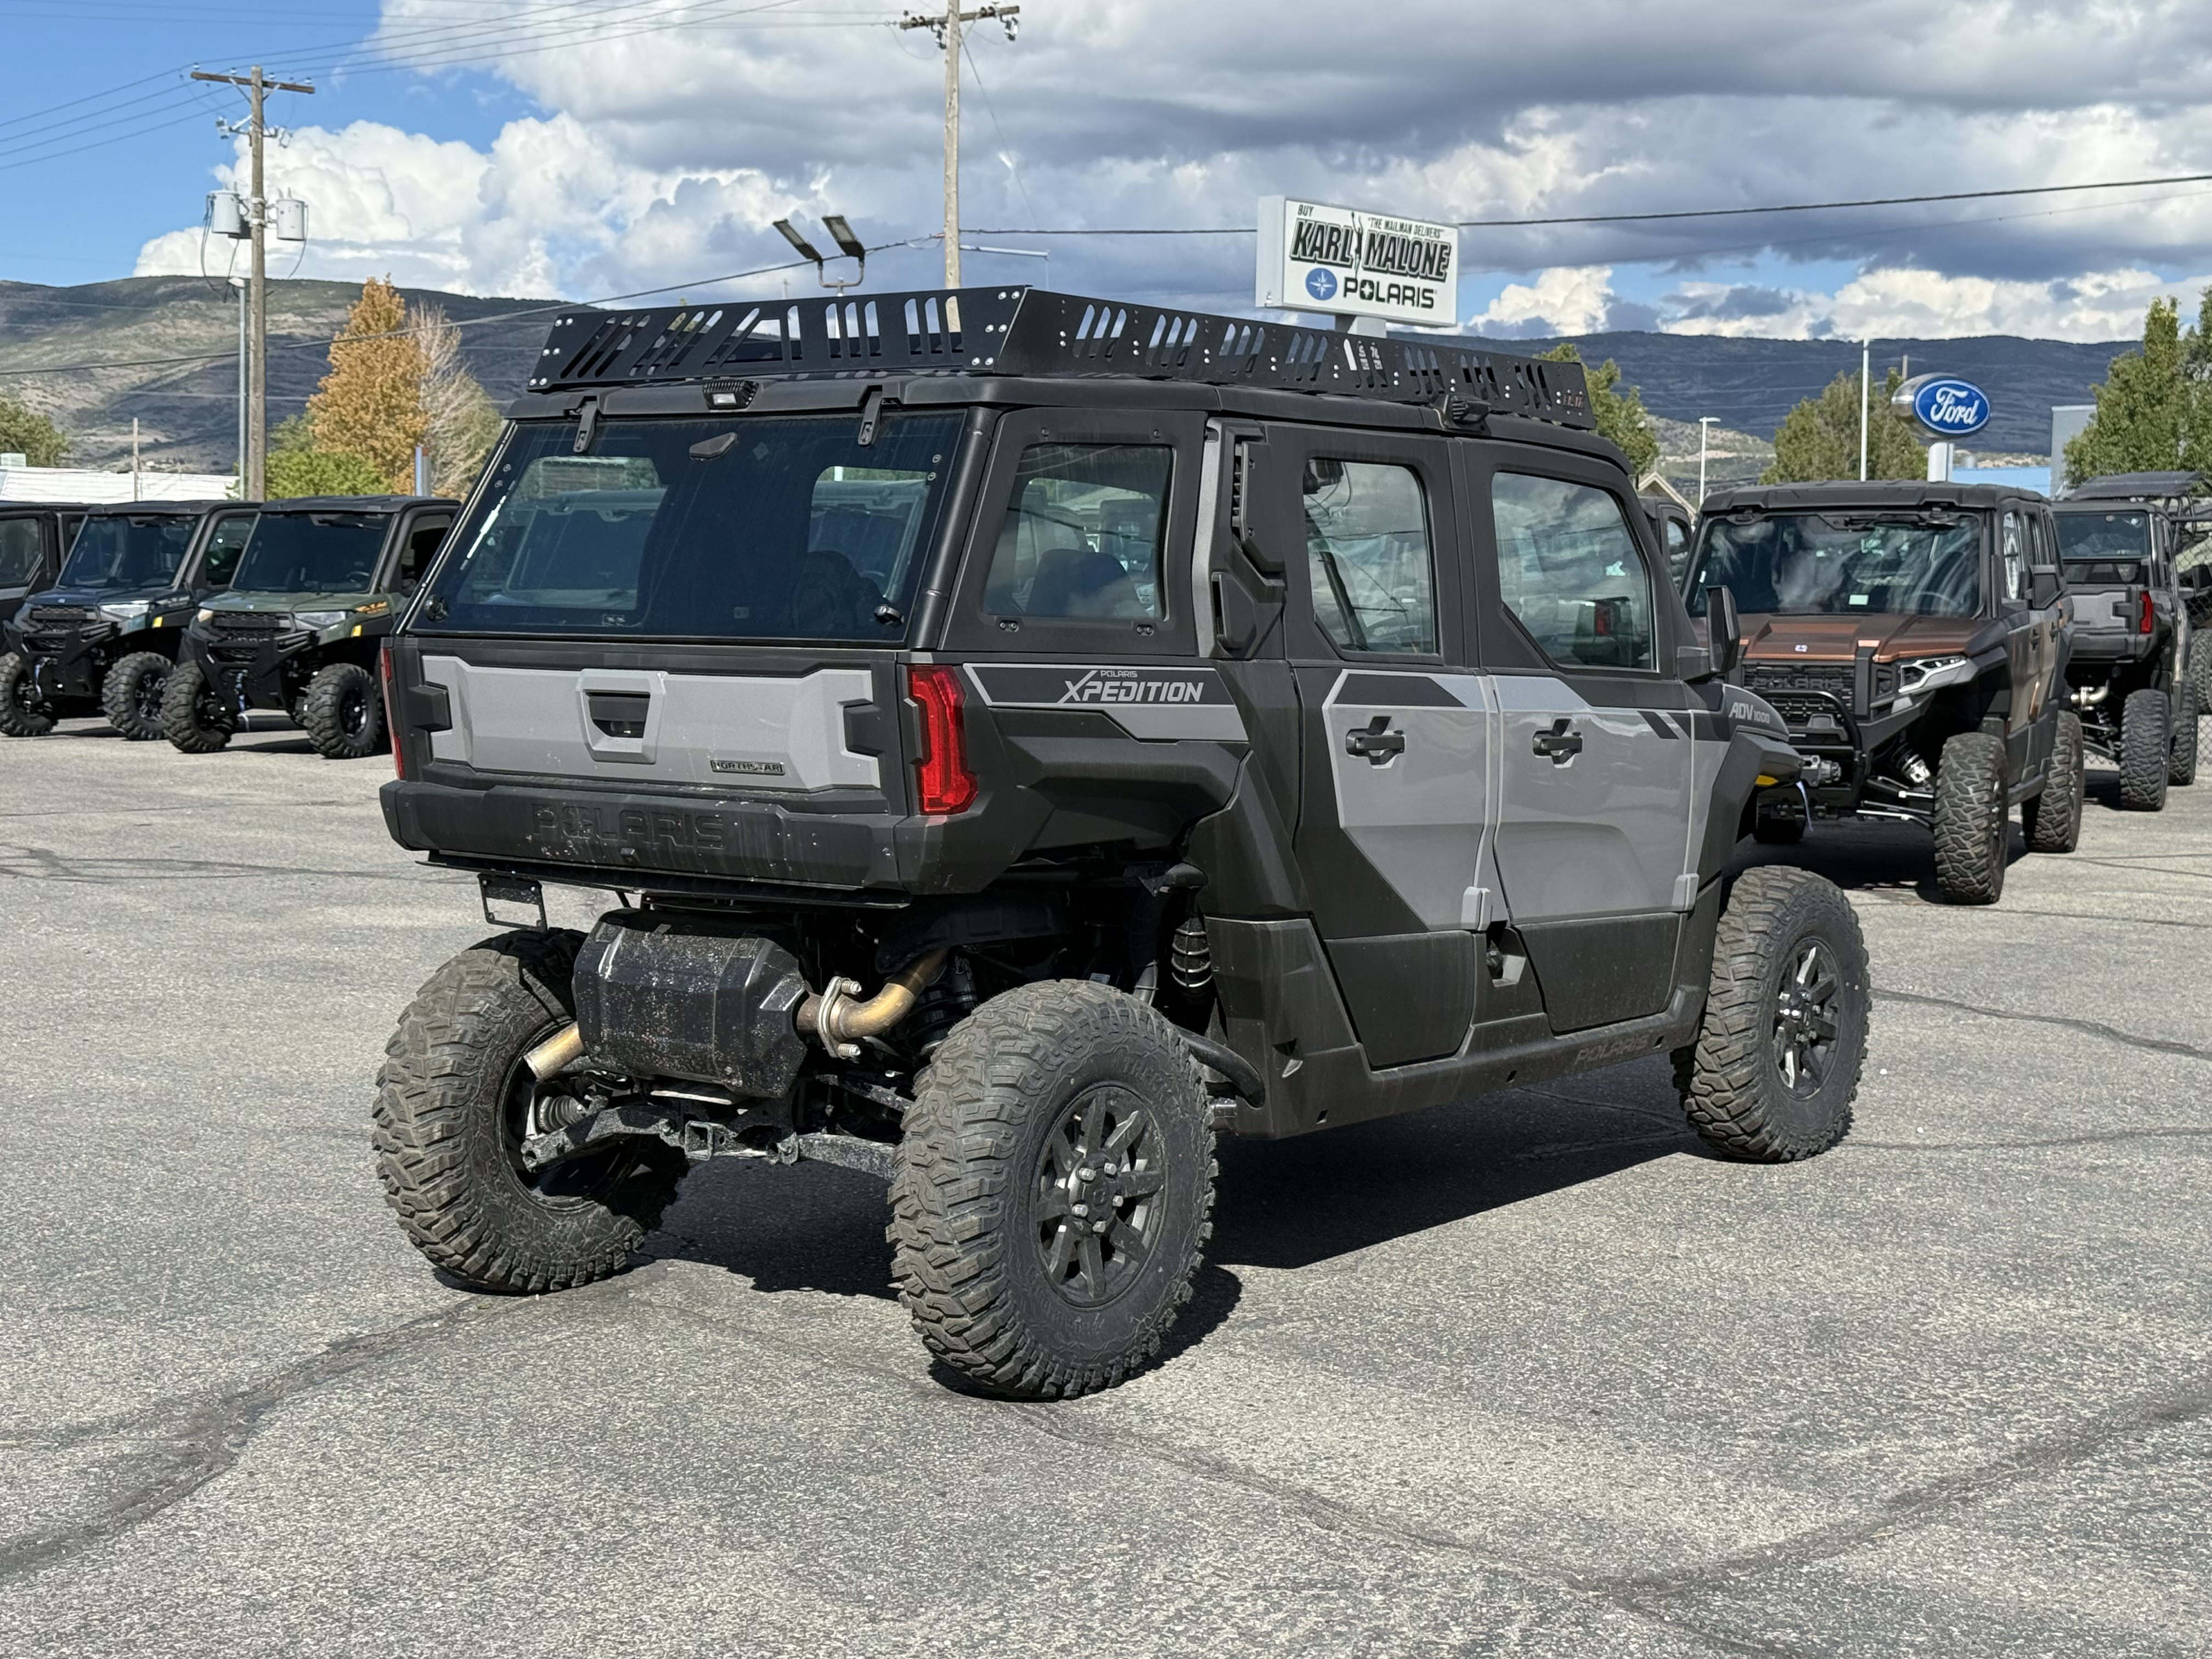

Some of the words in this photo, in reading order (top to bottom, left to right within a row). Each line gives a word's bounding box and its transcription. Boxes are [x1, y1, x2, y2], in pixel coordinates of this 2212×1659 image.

[1297, 204, 1314, 217] BUY
[1384, 220, 1412, 234] MAILMAN
[1290, 218, 1353, 267] KARL
[1362, 231, 1451, 282] MALONE
[1344, 276, 1435, 309] POLARIS
[1930, 387, 1980, 425] Ford
[1058, 670, 1204, 704] XPEDITION
[1101, 669, 1138, 678] POLARIS
[531, 803, 726, 850] POLARIS
